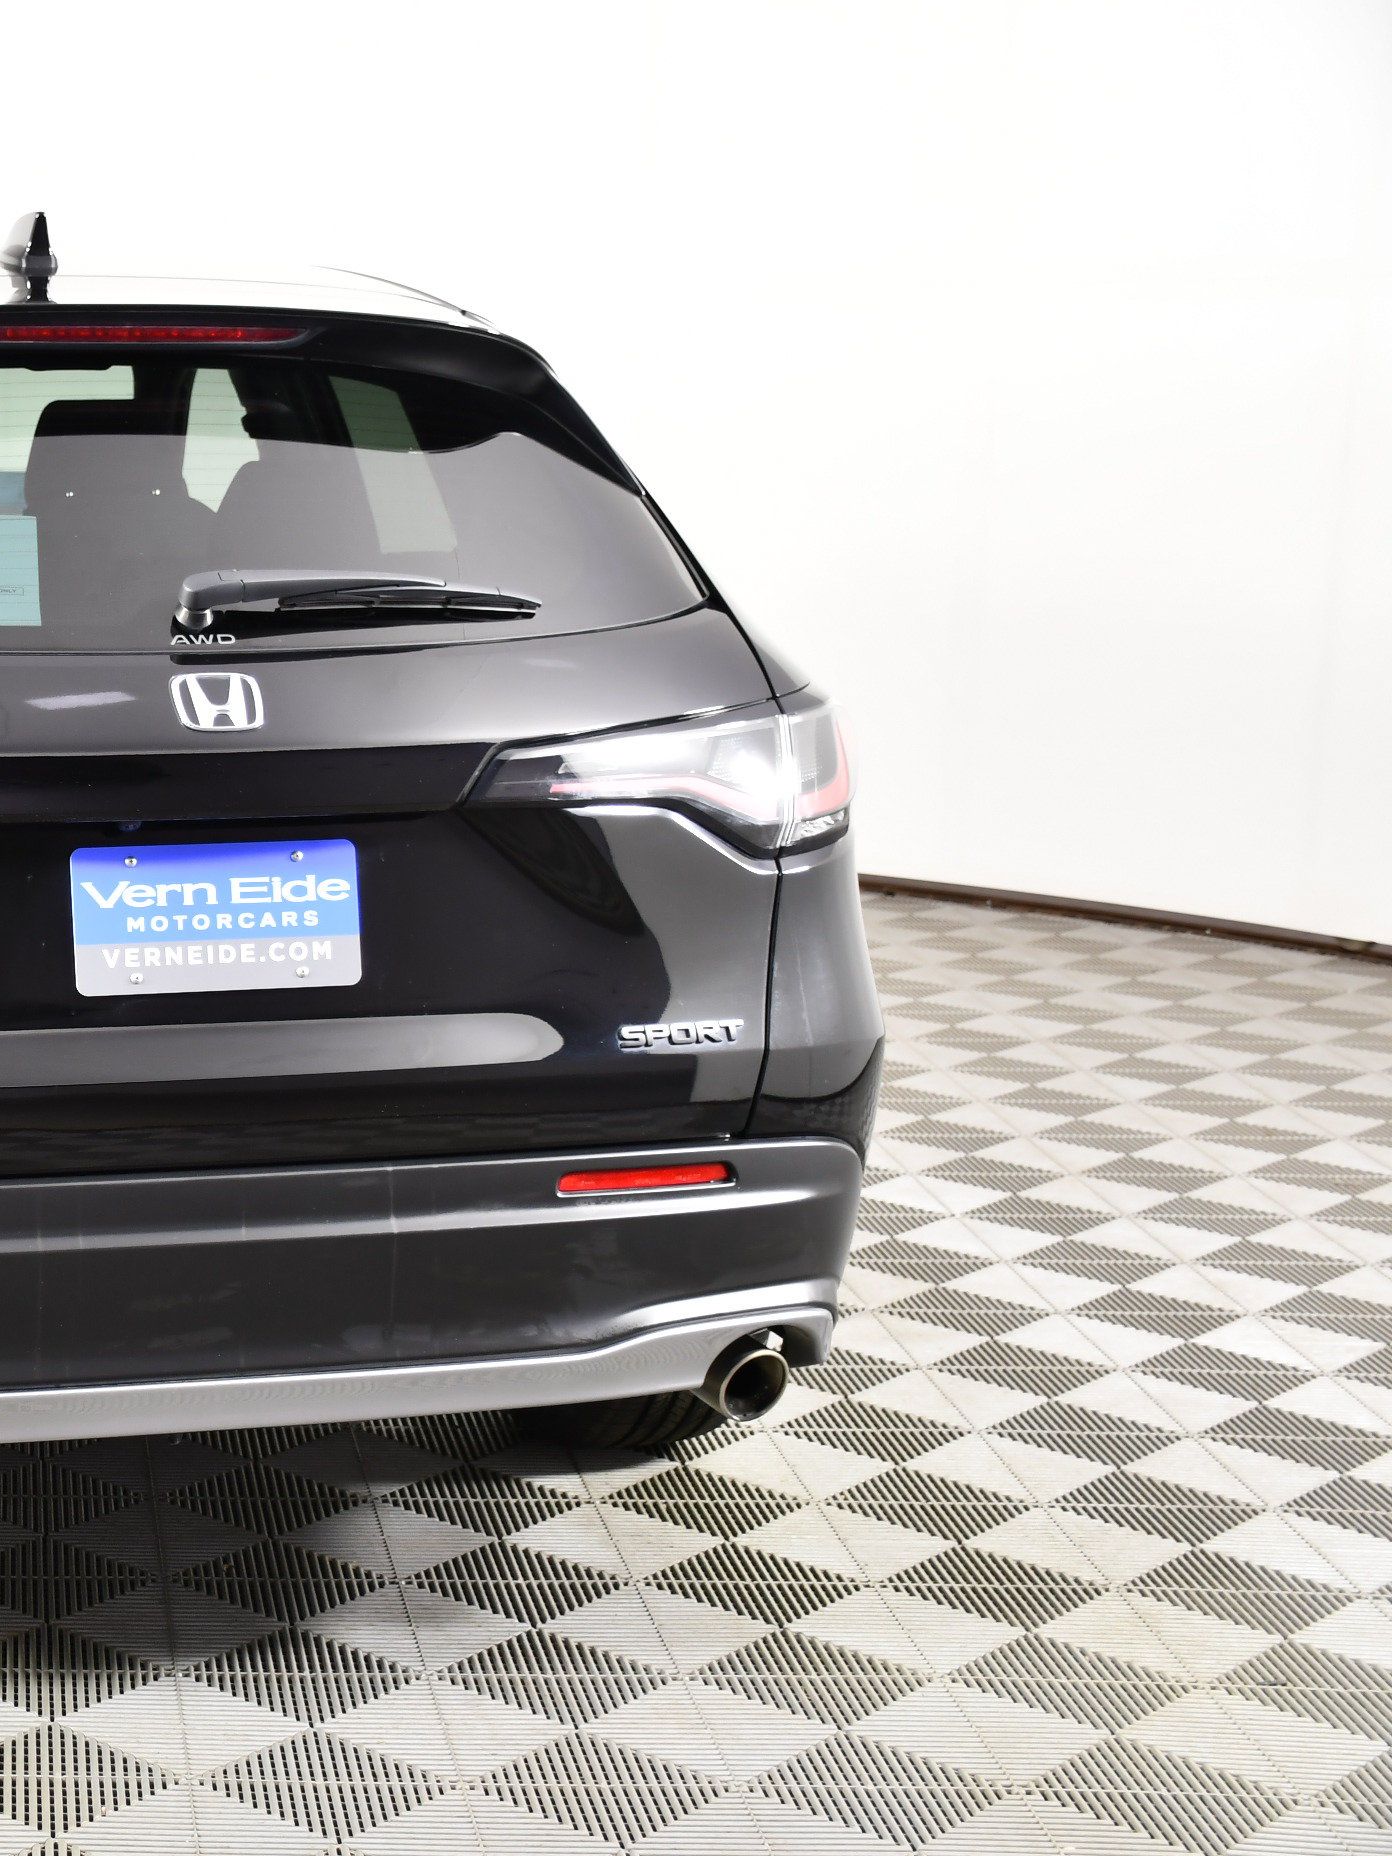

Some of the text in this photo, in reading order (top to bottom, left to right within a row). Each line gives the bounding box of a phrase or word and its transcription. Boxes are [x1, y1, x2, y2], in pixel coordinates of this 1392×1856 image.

[170, 634, 236, 645] AWD
[80, 874, 351, 909] Vern Eide
[126, 910, 319, 933] MOTORCARS
[102, 940, 333, 969] VERNEIDE.COM
[618, 1019, 744, 1048] SPORT
